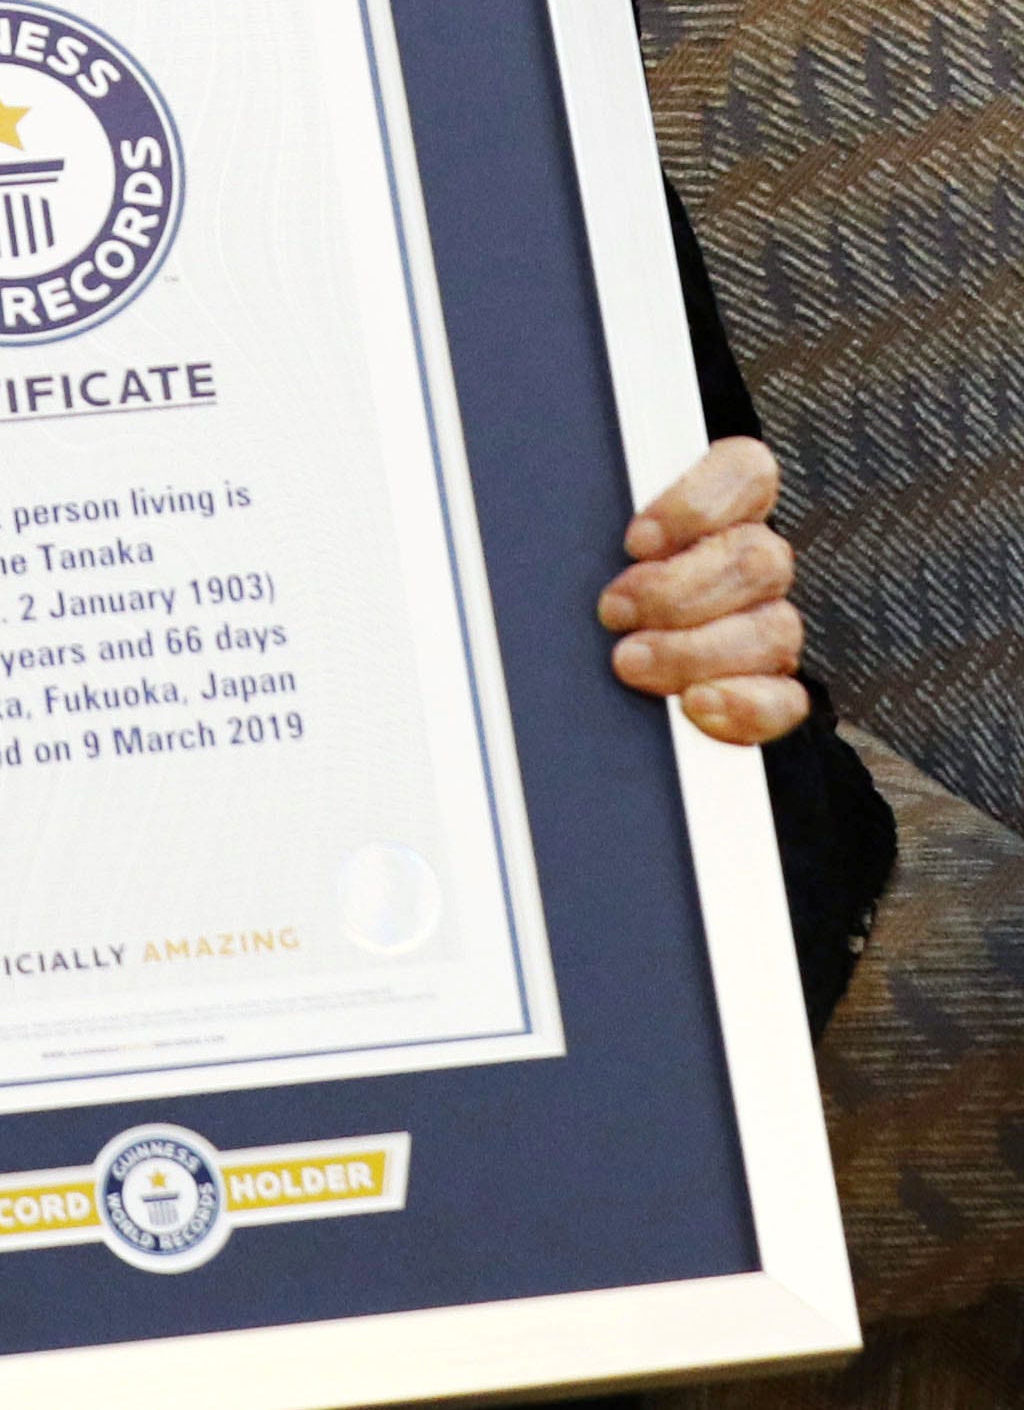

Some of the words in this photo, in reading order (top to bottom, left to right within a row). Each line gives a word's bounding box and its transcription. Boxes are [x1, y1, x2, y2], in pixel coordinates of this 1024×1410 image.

[0, 136, 164, 328] RECORDS
[12, 498, 121, 536] person
[129, 485, 216, 518] living
[224, 479, 252, 509] is
[36, 537, 155, 573] Tanaka
[18, 593, 37, 622] 2
[48, 589, 176, 620] January
[188, 572, 275, 606] 1903)
[98, 629, 155, 663] and
[165, 624, 203, 656] 66
[214, 622, 288, 655] days
[43, 676, 189, 716] Fukuoka,
[200, 671, 297, 704] Japan
[33, 741, 72, 764] on
[82, 729, 102, 760] 9
[111, 719, 217, 757] March
[226, 710, 305, 746] 2019
[142, 926, 301, 965] AMAZING
[111, 1140, 202, 1182] GUINNESS
[230, 1161, 374, 1202] HOLDER
[106, 1192, 156, 1249] WORLD
[158, 1182, 215, 1249] RECORDS
